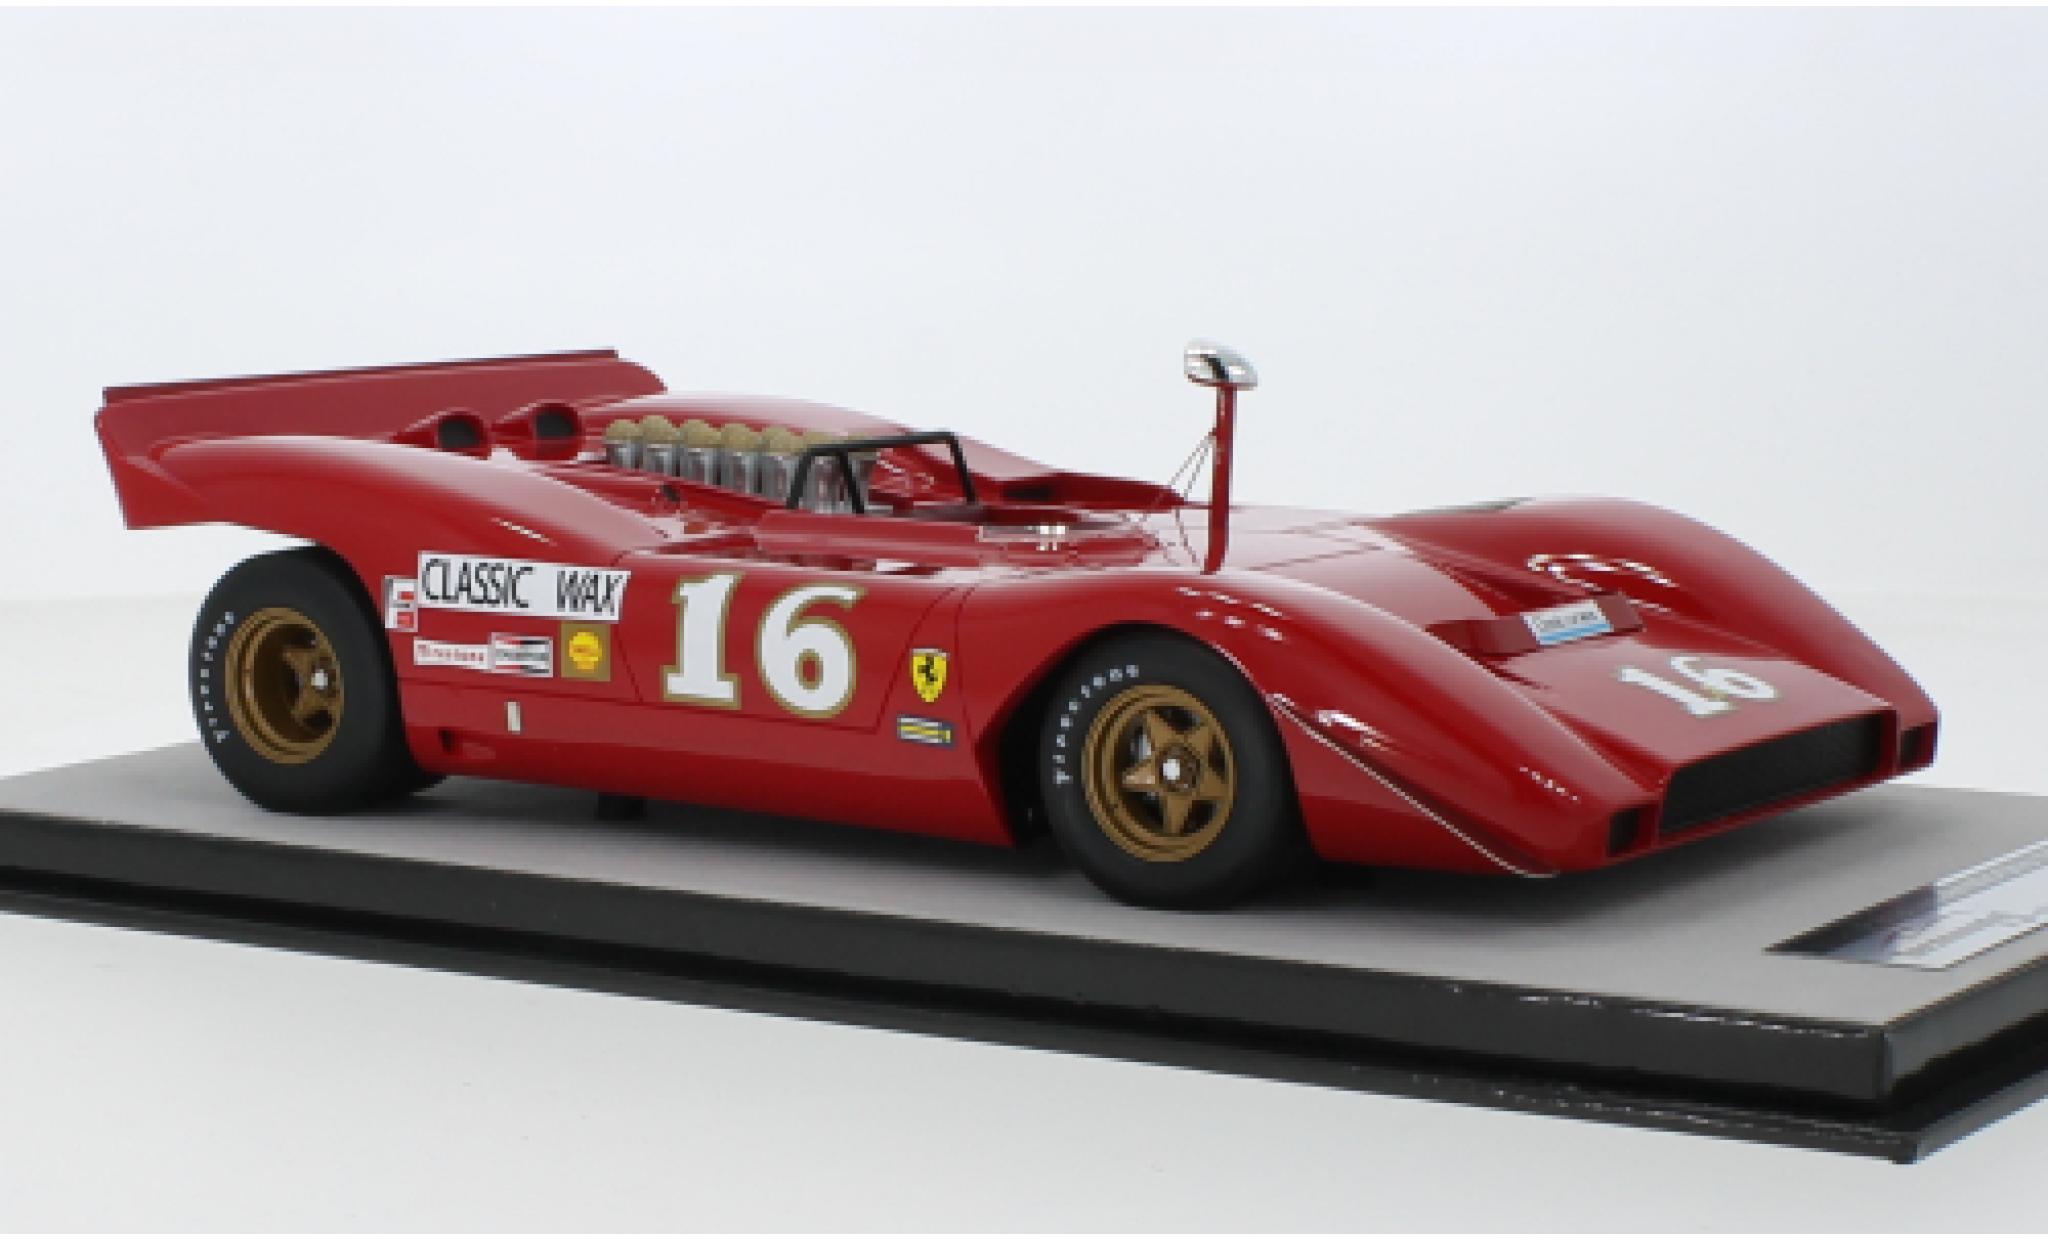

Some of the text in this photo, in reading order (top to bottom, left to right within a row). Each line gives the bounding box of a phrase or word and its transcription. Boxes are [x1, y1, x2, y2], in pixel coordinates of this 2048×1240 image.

[421, 557, 534, 609] CLASSIC
[556, 569, 624, 616] WAX
[660, 571, 867, 719] 16
[1617, 655, 1780, 718] 16
